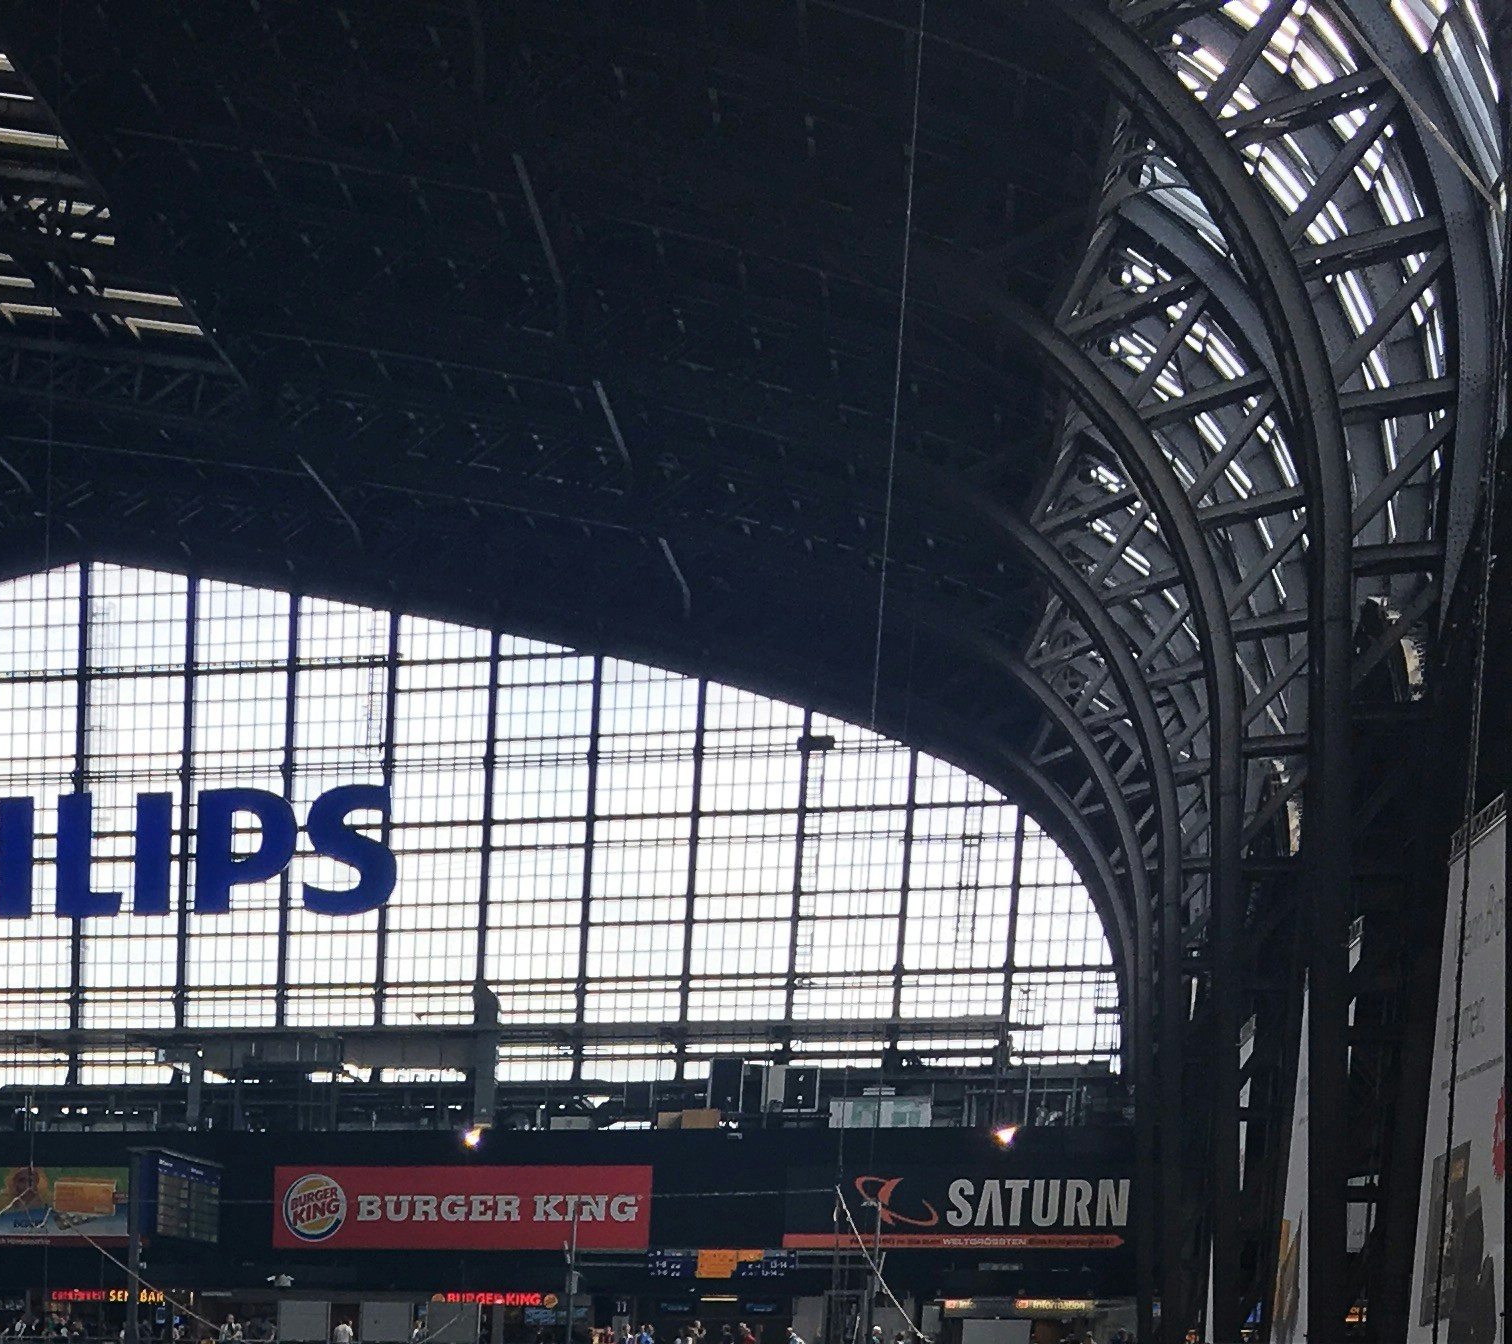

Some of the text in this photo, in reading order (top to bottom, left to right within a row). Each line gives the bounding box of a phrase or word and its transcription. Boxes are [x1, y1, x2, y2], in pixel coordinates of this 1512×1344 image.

[290, 1186, 338, 1203] BURGER
[946, 1178, 1130, 1227] SATURN
[292, 1200, 338, 1226] KING
[357, 1194, 638, 1222] BURGER KING
[505, 1293, 541, 1306] KING
[1032, 1300, 1086, 1310] Information
